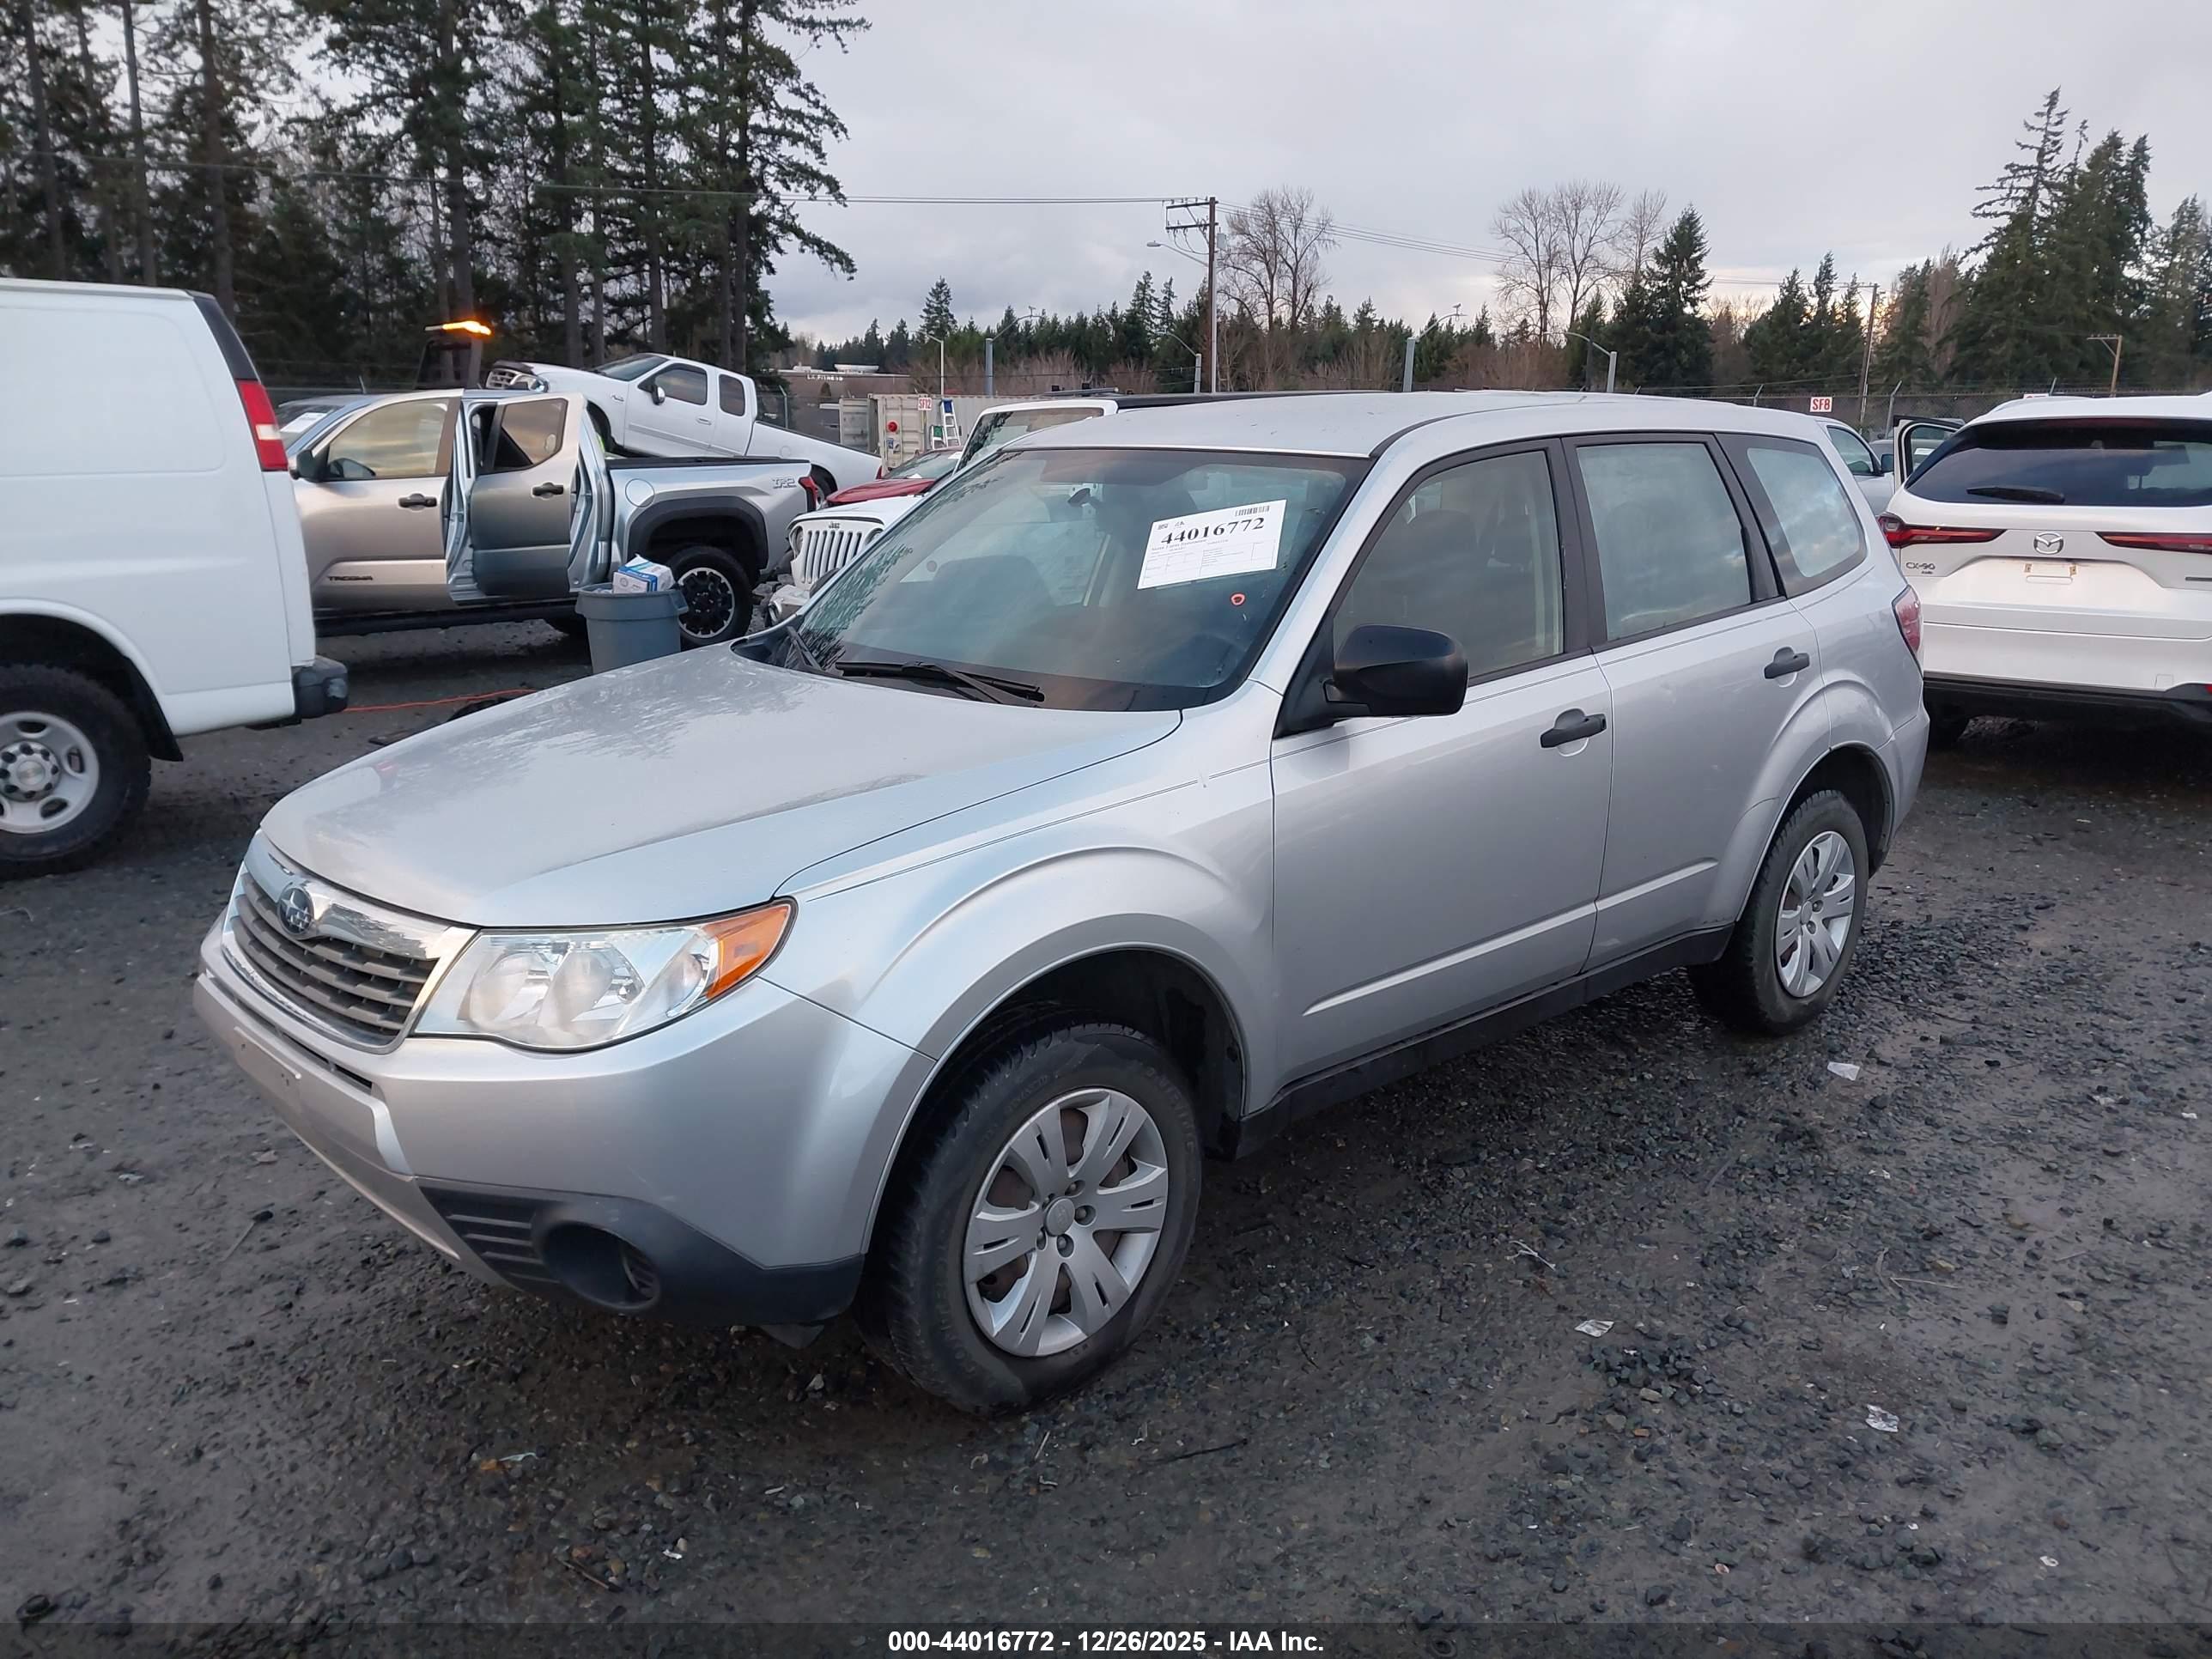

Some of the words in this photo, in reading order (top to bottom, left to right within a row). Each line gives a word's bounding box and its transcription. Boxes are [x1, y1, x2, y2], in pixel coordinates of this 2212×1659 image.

[919, 398, 931, 409] SF12
[1813, 398, 1831, 410] SF8
[1161, 517, 1265, 544] 44016772
